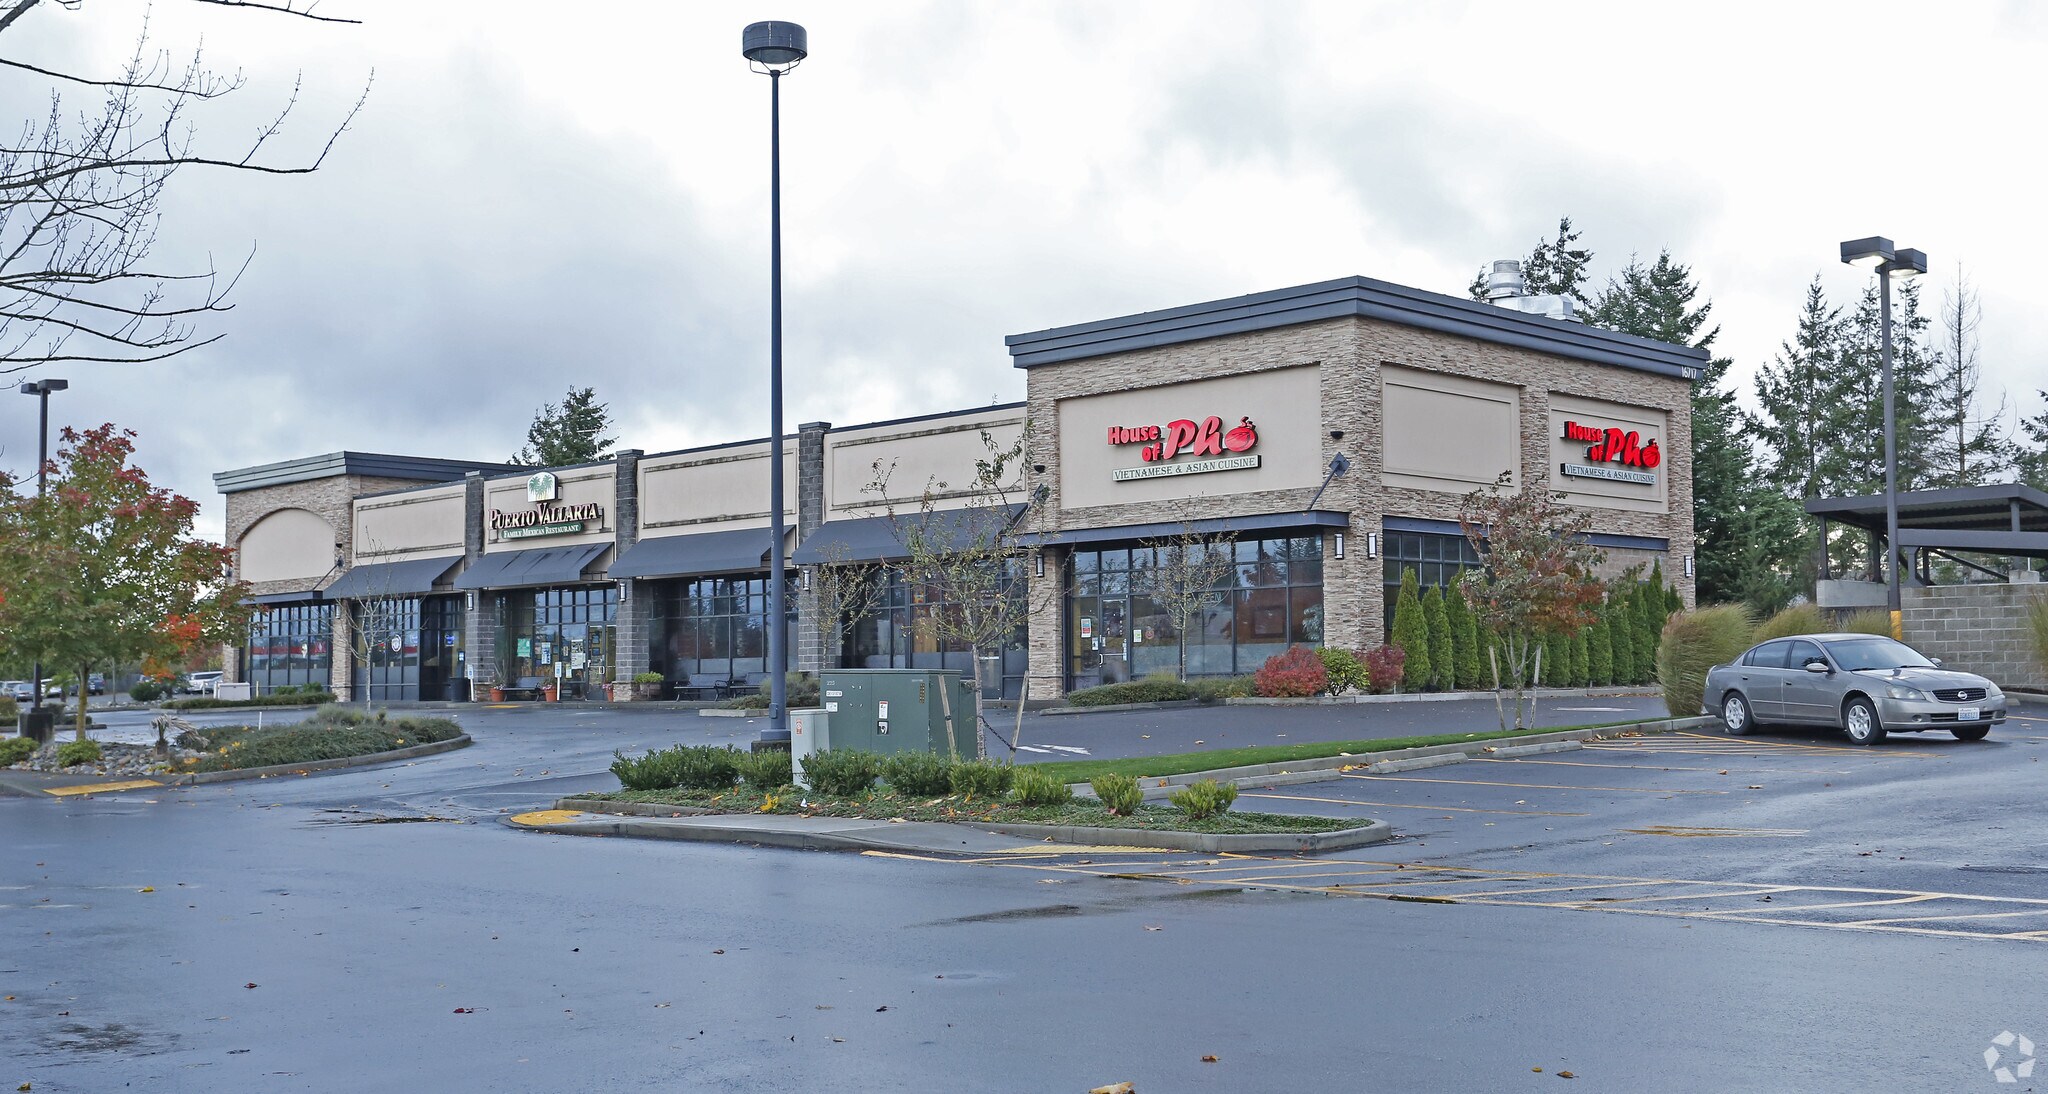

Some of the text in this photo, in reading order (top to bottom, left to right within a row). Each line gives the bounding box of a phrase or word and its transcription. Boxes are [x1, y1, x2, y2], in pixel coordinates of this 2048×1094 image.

[1108, 425, 1160, 445] House
[1163, 416, 1259, 460] Pho
[1565, 421, 1603, 442] House
[1142, 442, 1161, 462] of
[1589, 444, 1604, 462] of
[1604, 428, 1661, 468] Pho
[1114, 457, 1256, 480] VIETNAMESE & ASIAN CUISINE
[1566, 464, 1655, 483] VIETNAMESE & ASIAN CUISINE
[488, 502, 599, 530] PUERTO VALLARTA
[503, 524, 579, 539] FAMILY MEXICAN RESTAURANT
